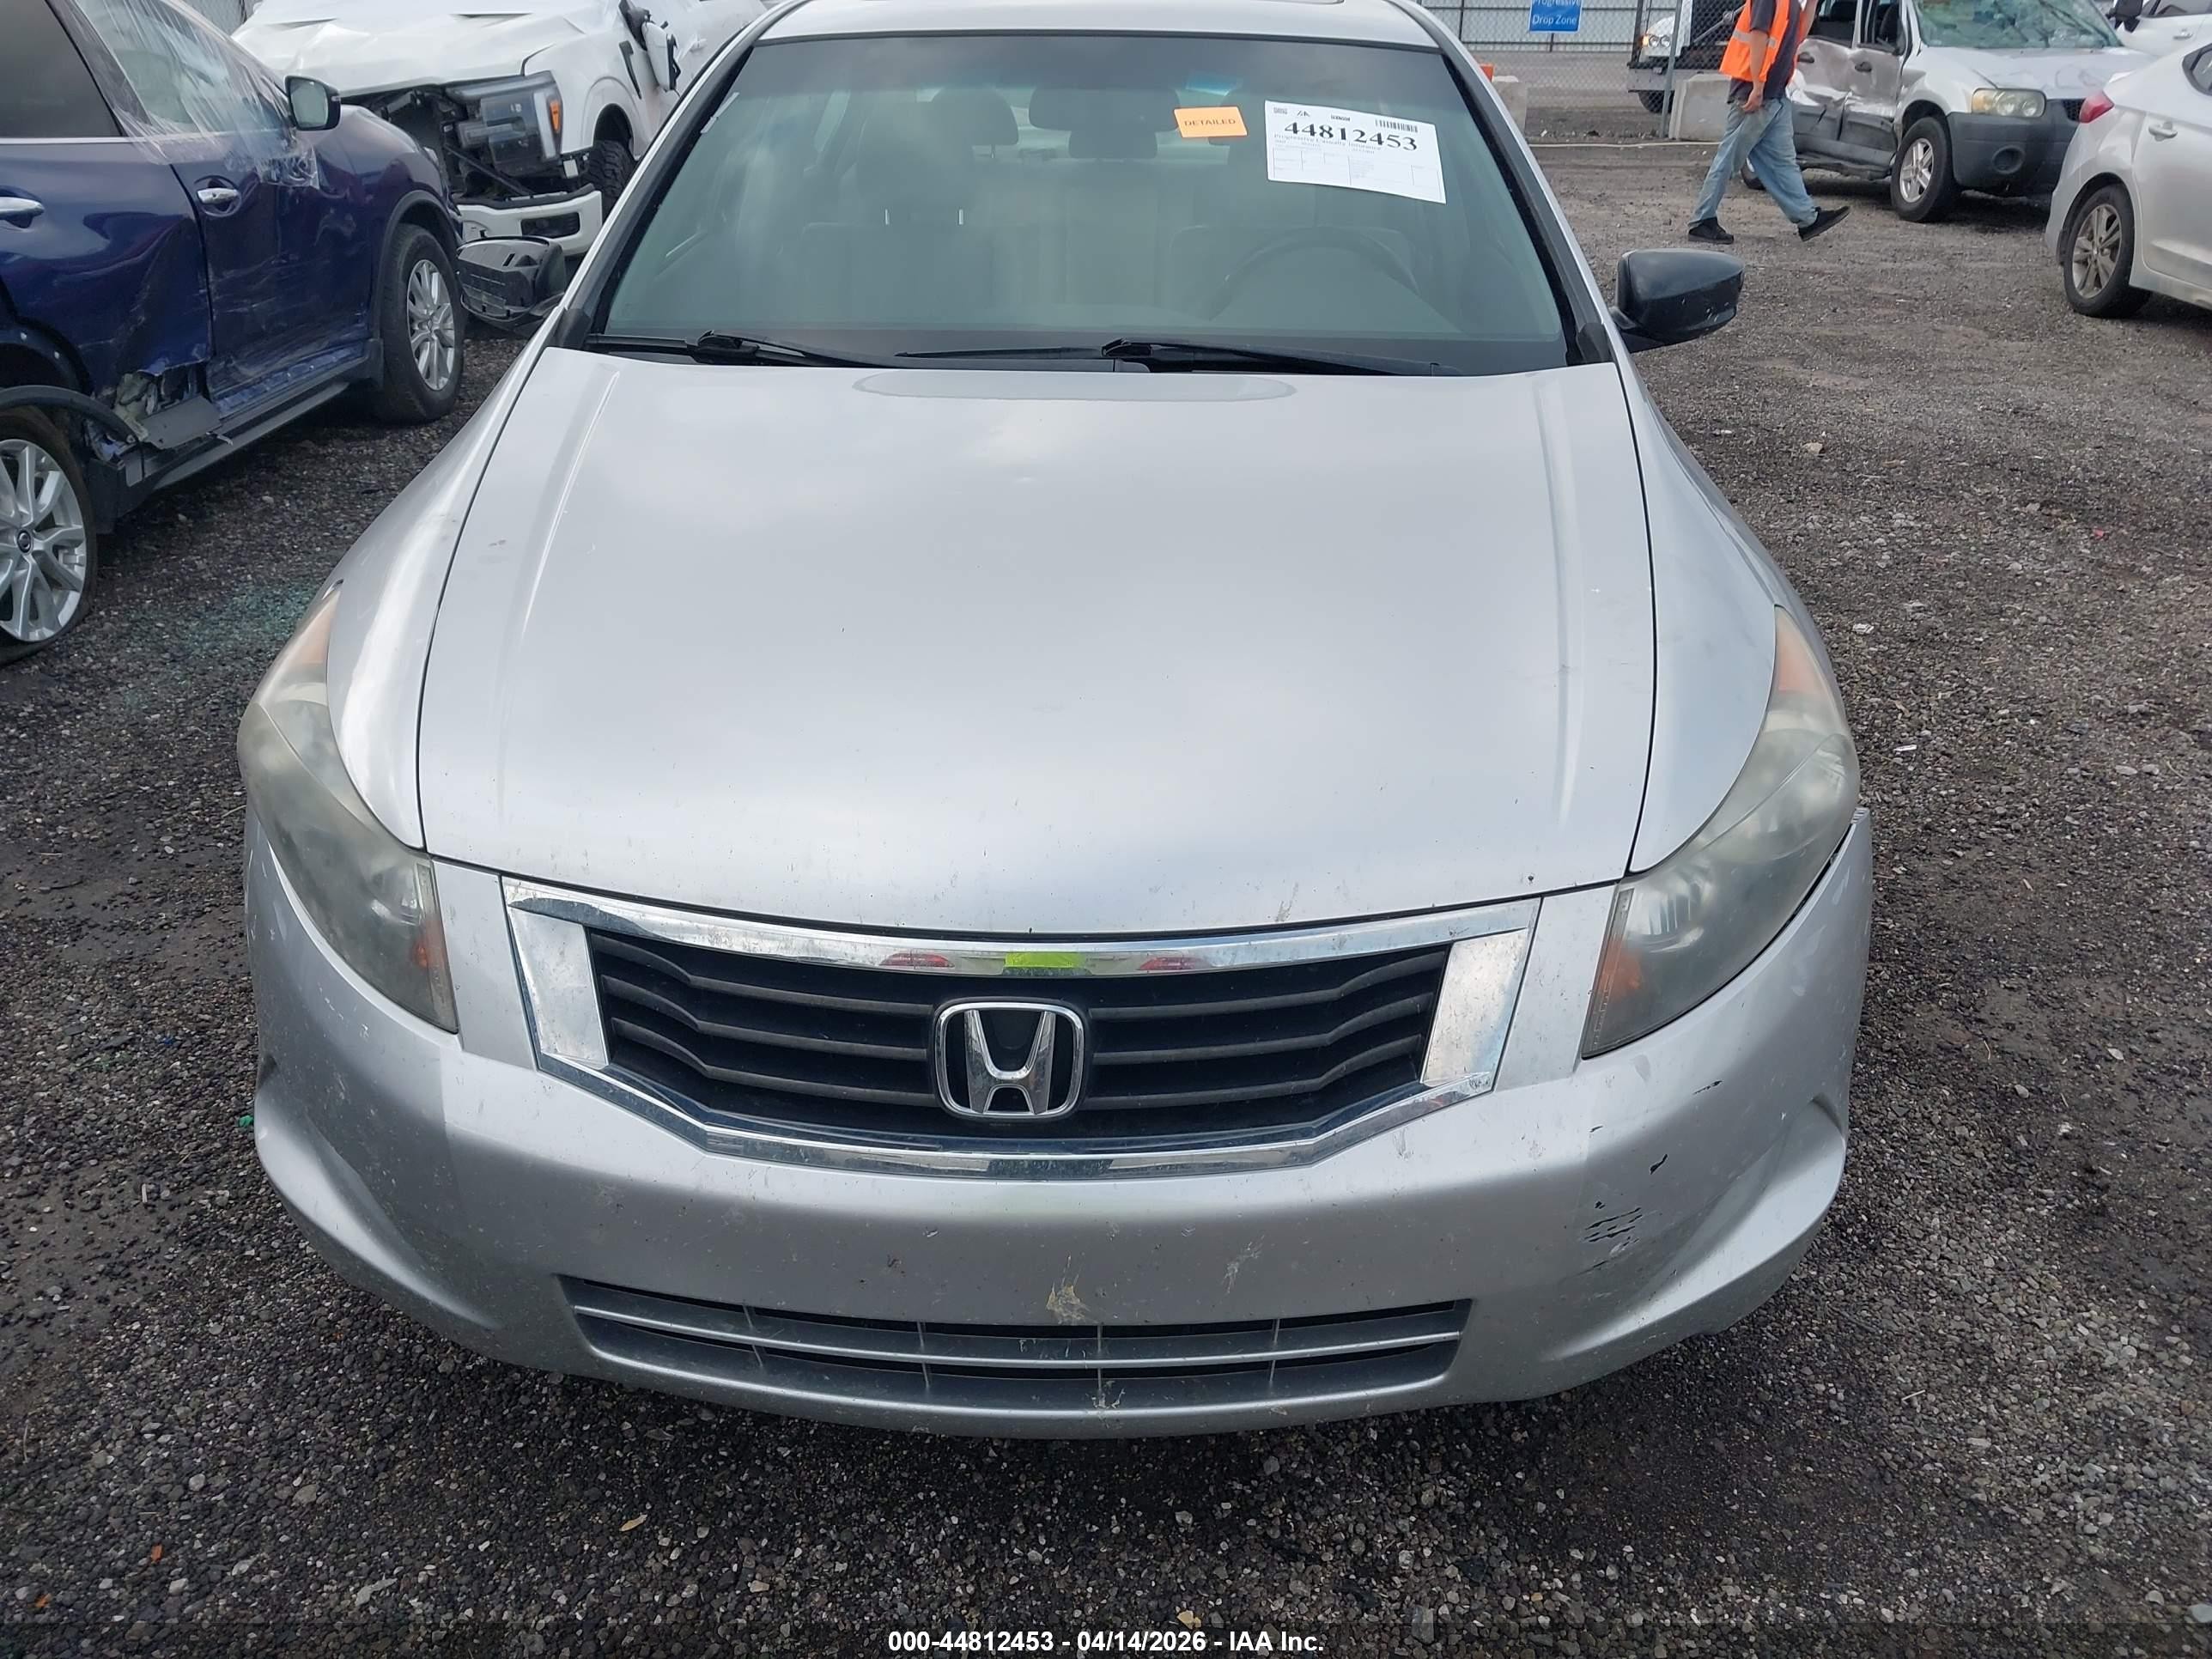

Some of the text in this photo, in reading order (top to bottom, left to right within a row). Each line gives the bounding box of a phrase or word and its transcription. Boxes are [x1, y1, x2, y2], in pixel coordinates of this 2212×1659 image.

[1532, 15, 1577, 27] Drop Zone
[1183, 118, 1236, 127] DETAILED
[1285, 121, 1418, 152] 44812453
